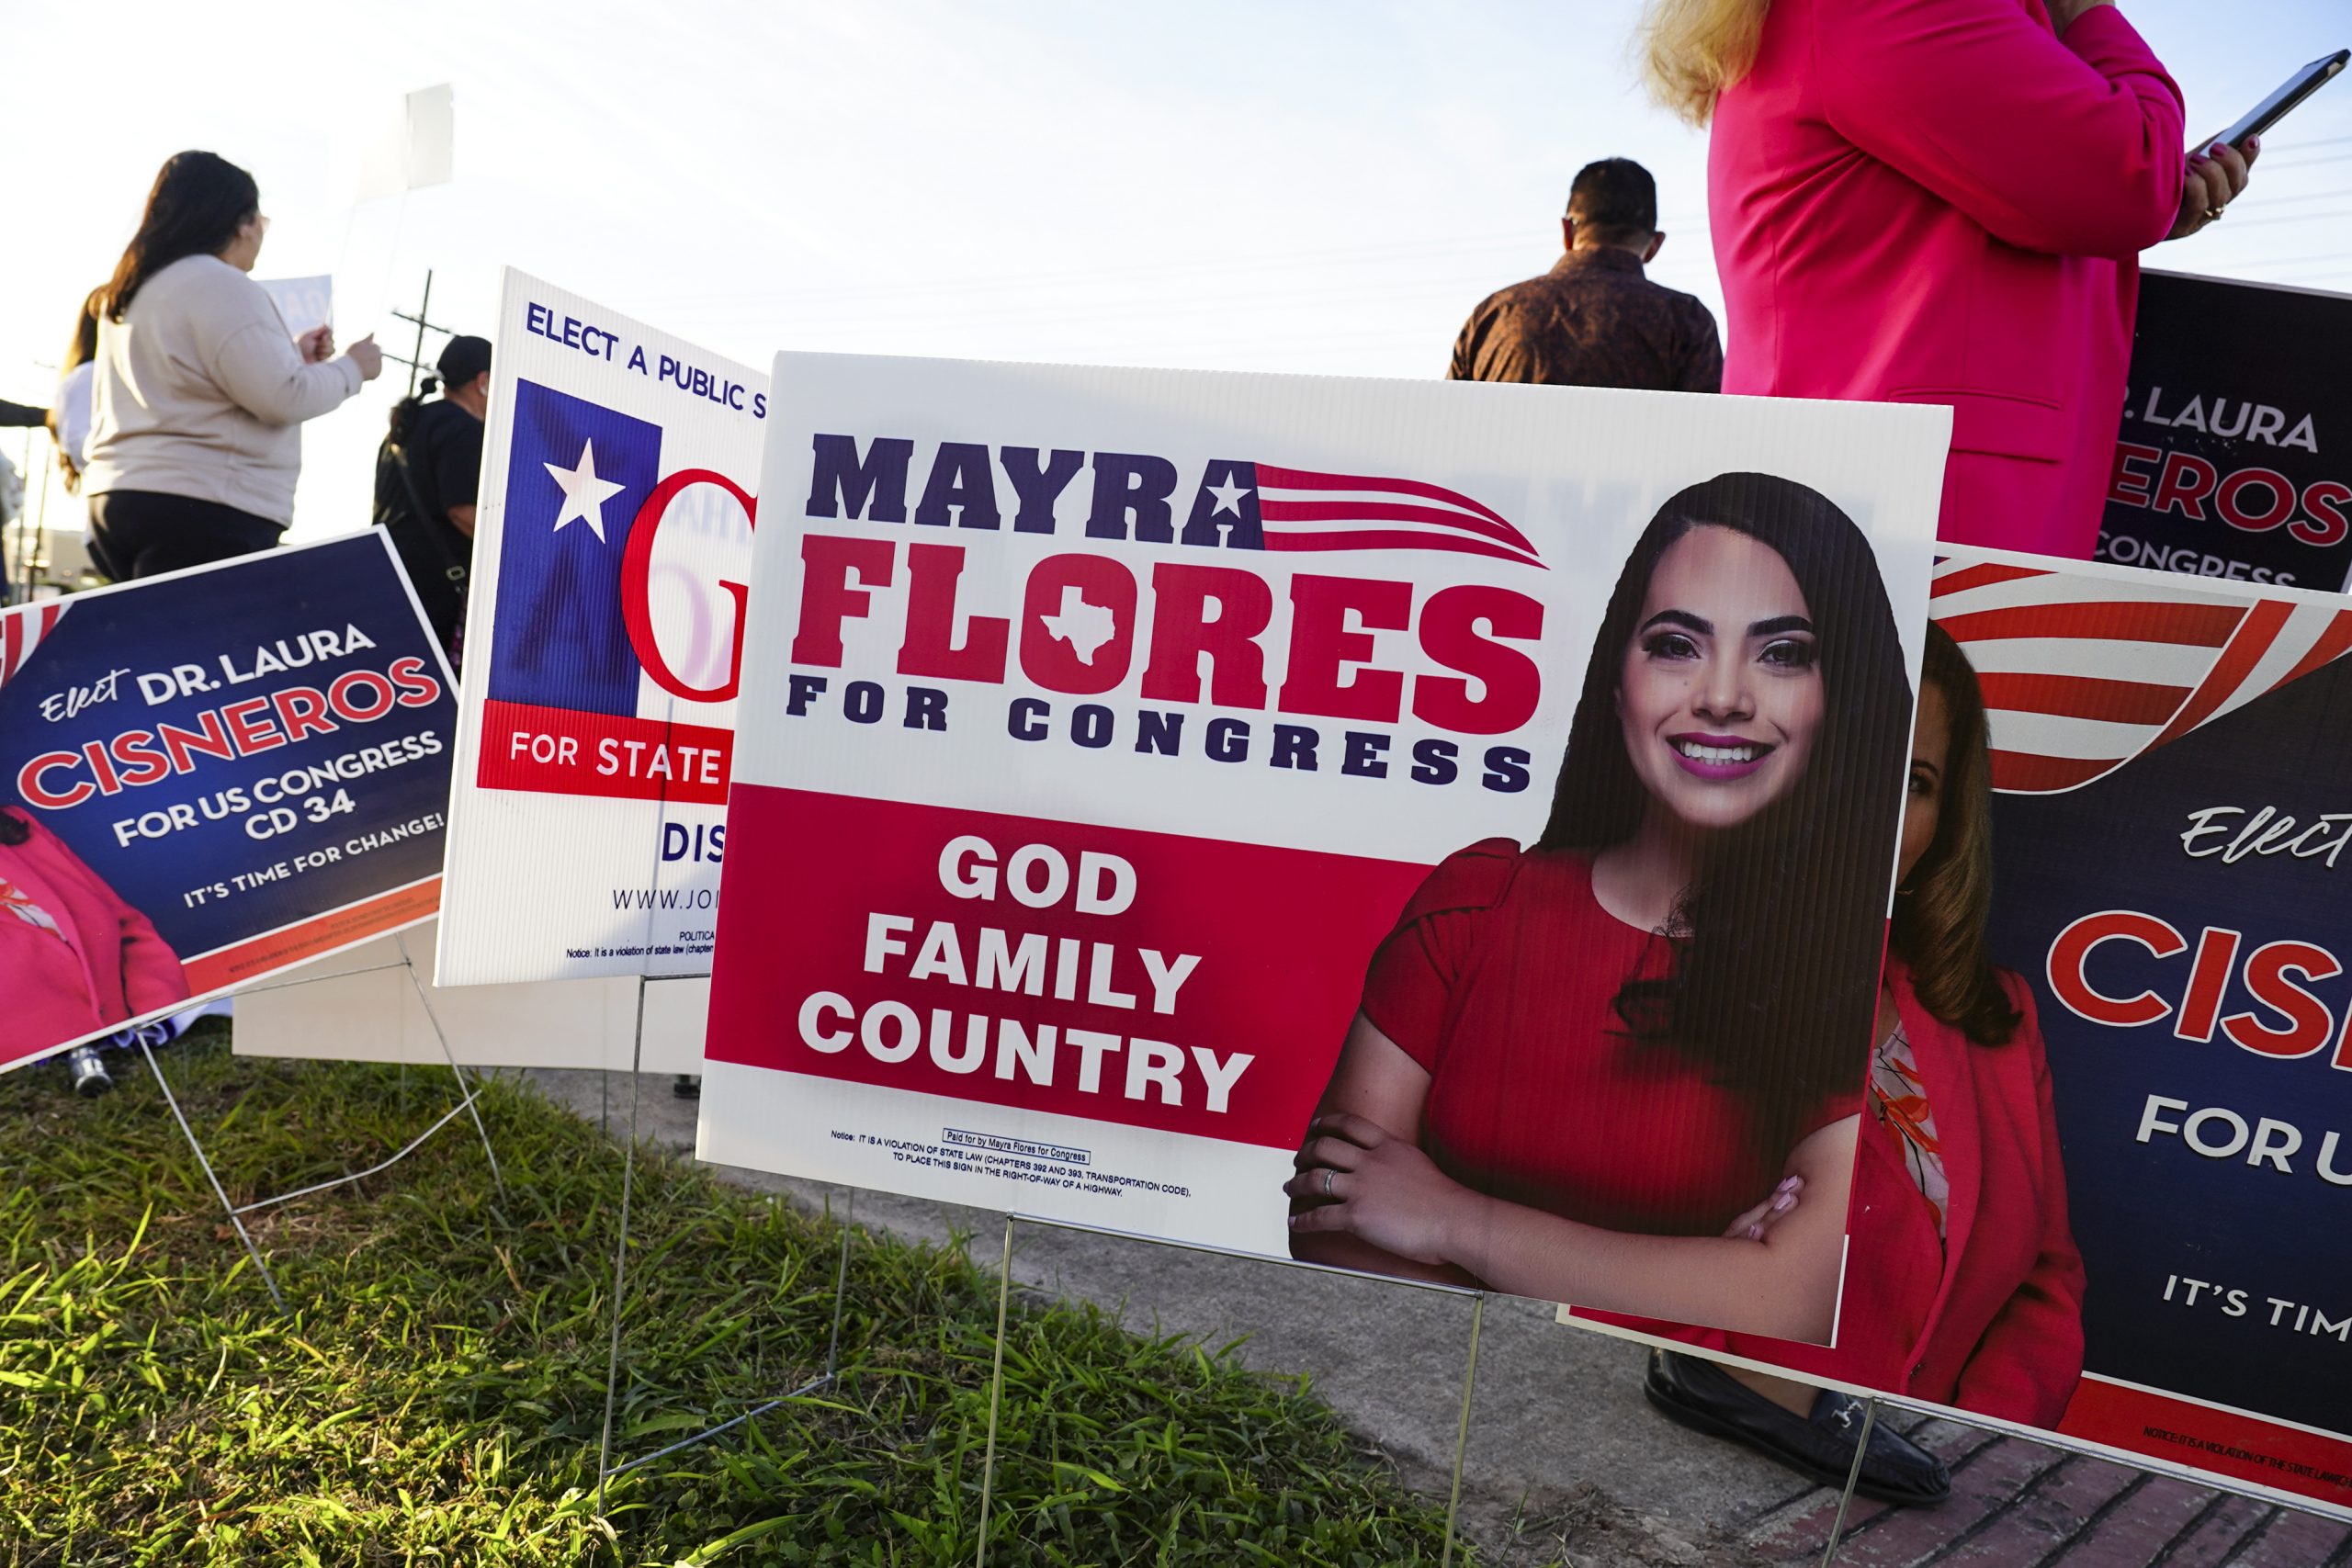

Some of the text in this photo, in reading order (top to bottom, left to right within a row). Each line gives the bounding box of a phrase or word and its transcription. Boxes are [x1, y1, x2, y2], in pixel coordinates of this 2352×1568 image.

[526, 301, 618, 361] ELECT
[628, 345, 648, 376] A
[659, 355, 744, 411] PUBLIC
[2143, 386, 2318, 454] LAURA
[805, 433, 1264, 550] MAYRA
[39, 624, 377, 723] Elect DR. LAURA
[791, 534, 1545, 735] FLORES
[17, 657, 441, 810] CISNEROS
[511, 732, 721, 784] FOR STATE
[786, 673, 1532, 794] FOR CONGRESS
[111, 730, 443, 847] FOR US CONGRESS
[244, 789, 356, 841] CD 34
[184, 812, 446, 908] IT'S TIME FOR CHANGE!
[938, 835, 1137, 916] GOD
[566, 948, 593, 958] Notice:
[594, 947, 600, 957] It
[601, 947, 607, 957] is
[616, 946, 644, 956] violation
[646, 945, 653, 954] of
[654, 945, 671, 954] state
[673, 944, 684, 953] law
[679, 931, 715, 942] POLITICA
[863, 912, 1203, 1016] FAMILY
[2045, 909, 2352, 1071] CIS
[797, 991, 1256, 1114] COUNTRY
[831, 1130, 855, 1142] Notice:
[867, 1136, 876, 1145] IS
[876, 1138, 882, 1146] A
[884, 1139, 925, 1153] VIOLATION
[927, 1145, 938, 1155] OF
[940, 1148, 964, 1159] STATE
[965, 1152, 983, 1162] LAW
[984, 1156, 1032, 1170] (CHAPTERS
[1033, 1163, 1047, 1173] 392
[1048, 1166, 1066, 1176] AND
[1086, 1171, 1160, 1191] TRANSPORTATION
[893, 1152, 1123, 1197] TO PLACE THIS SIGN IN THE RIGHT-OF-WAY OF A HIGHWAY.
[946, 1131, 1086, 1162] Paid for by Mayra Flores for Congress
[2135, 1093, 2302, 1175] FOR
[2163, 1274, 2249, 1317] IT'S
[2143, 1426, 2177, 1443] NOTICE:
[2206, 1441, 2252, 1461] VIOLATION
[2254, 1453, 2267, 1465] OF
[2268, 1457, 2287, 1470] THE
